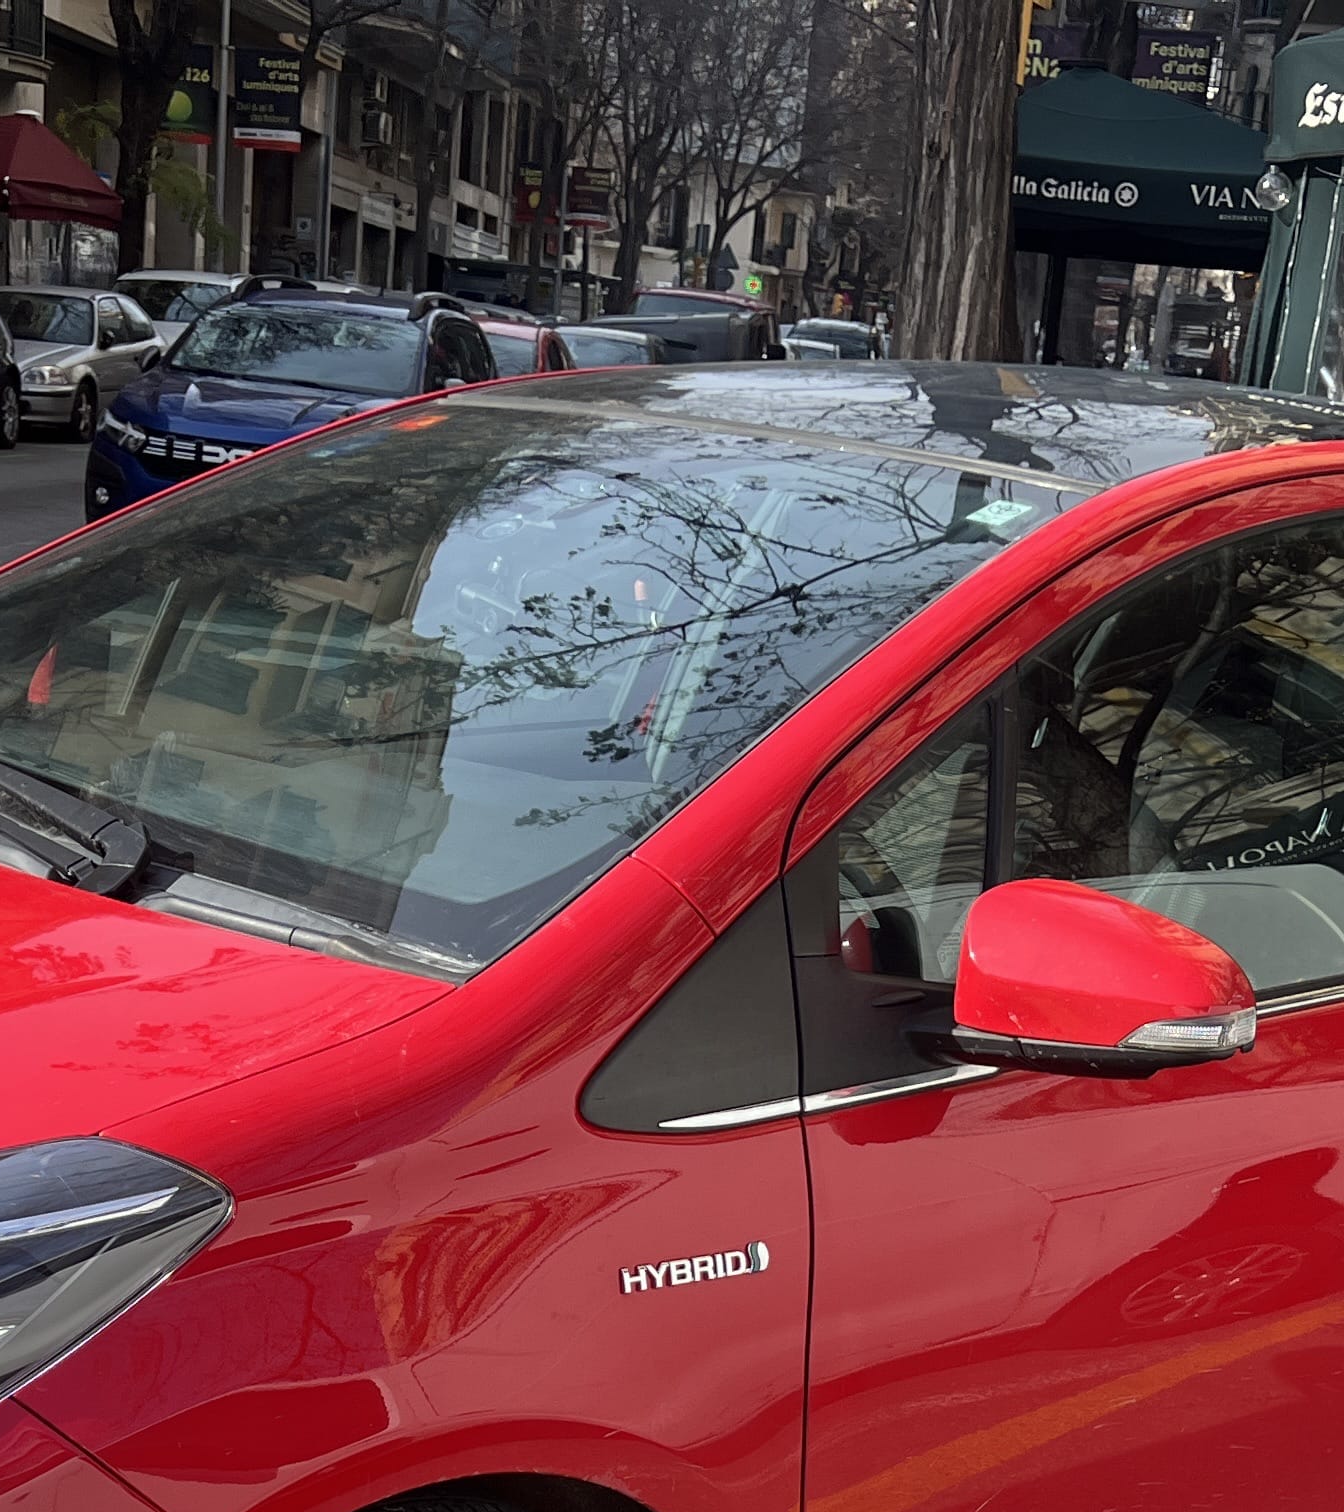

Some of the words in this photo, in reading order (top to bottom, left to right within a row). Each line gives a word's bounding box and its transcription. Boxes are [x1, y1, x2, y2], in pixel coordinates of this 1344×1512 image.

[1150, 41, 1210, 59] Festival
[1162, 60, 1208, 76] d'arts
[1040, 177, 1110, 204] Galicia
[1191, 184, 1233, 208] VIA
[620, 1250, 748, 1294] HYBRID
